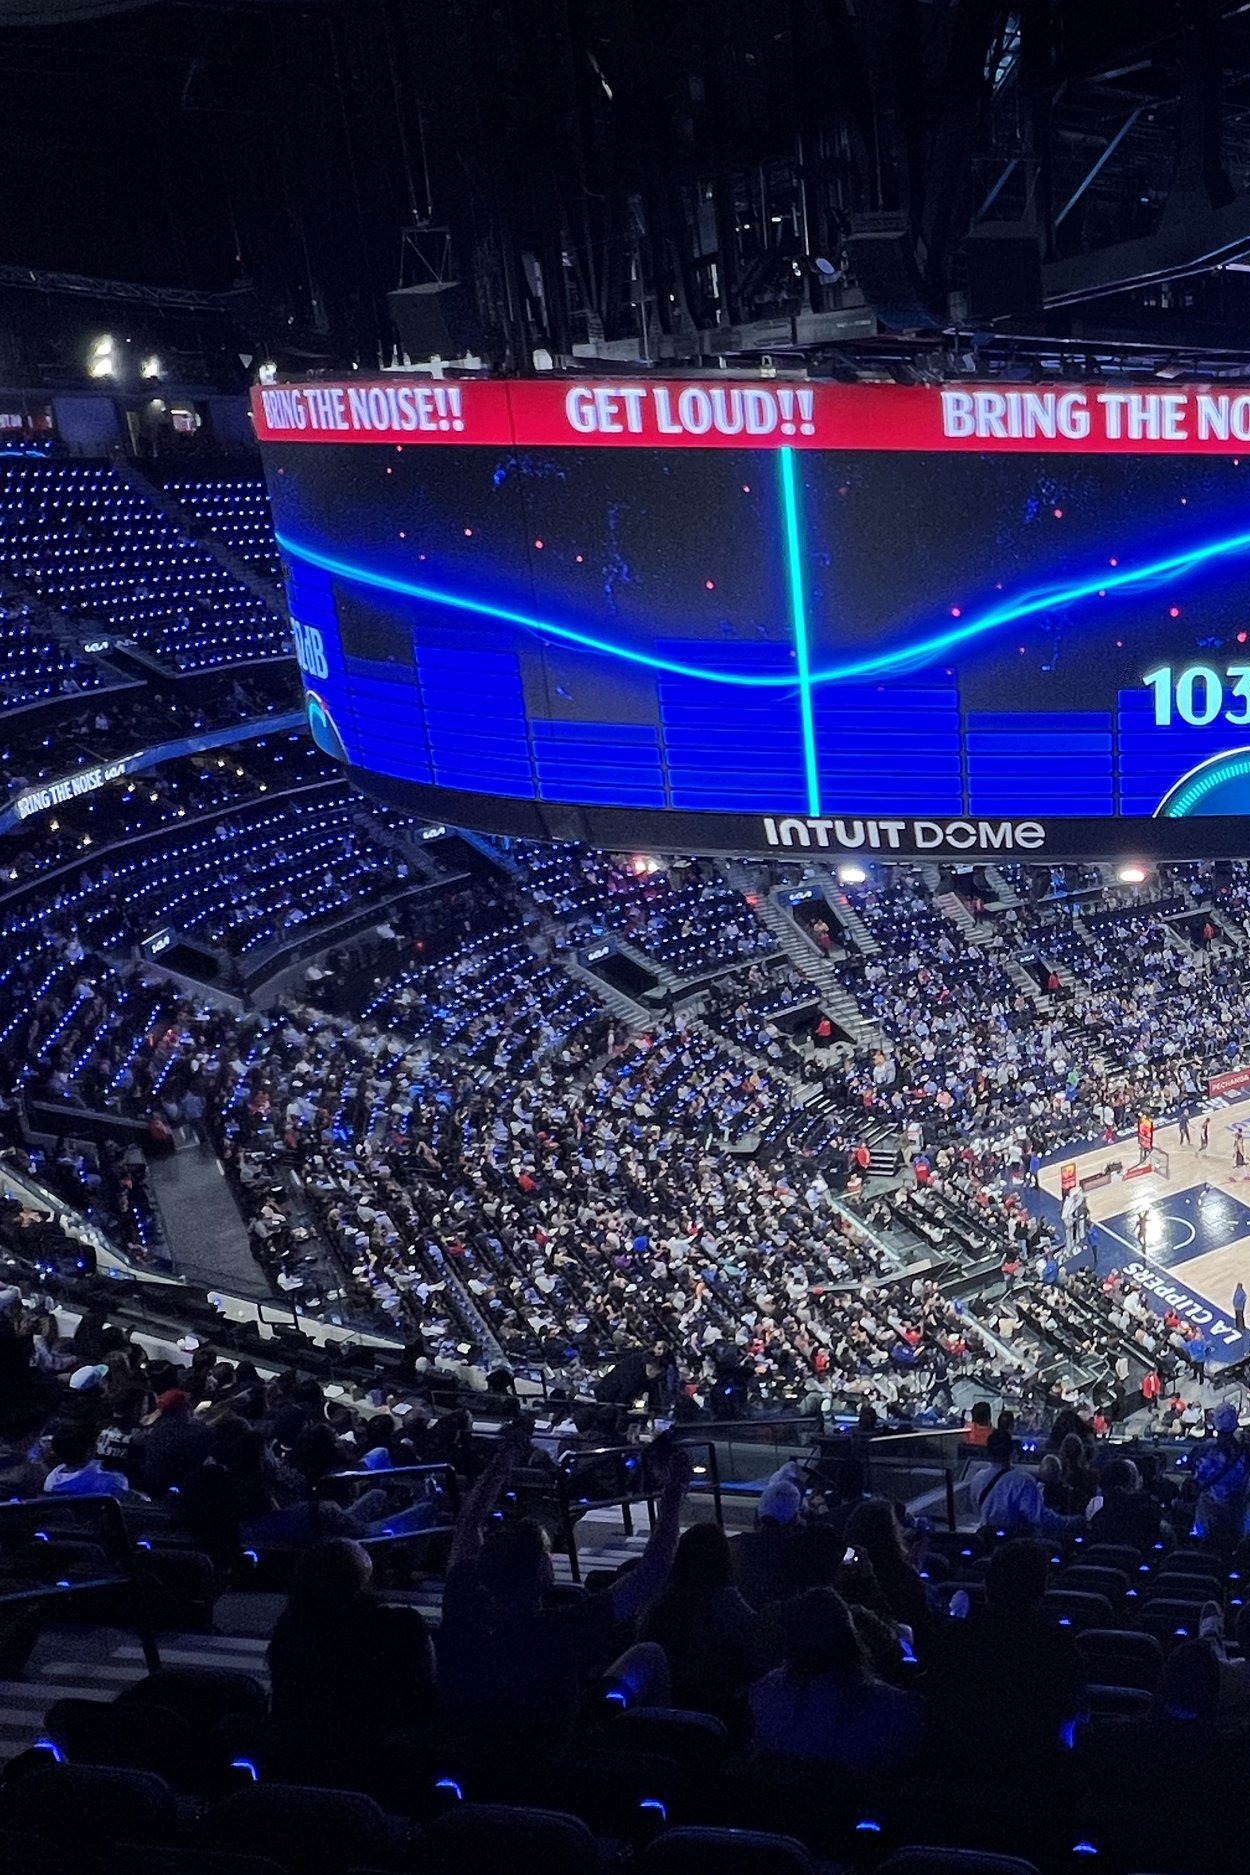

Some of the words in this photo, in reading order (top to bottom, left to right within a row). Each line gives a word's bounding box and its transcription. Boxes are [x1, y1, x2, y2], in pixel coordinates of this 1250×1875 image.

[261, 388, 306, 430] BRING
[303, 387, 349, 430] THE
[347, 386, 465, 432] NOISE!!
[565, 387, 647, 433] GET
[652, 388, 816, 435] LOUD!!
[940, 391, 1091, 438] BRING
[1096, 393, 1188, 440] THE
[49, 781, 74, 804] THE
[71, 768, 105, 797] NOISE
[763, 816, 906, 848] INTUIT
[1122, 1262, 1214, 1325] CLIPPERS
[1209, 1319, 1243, 1345] LA
